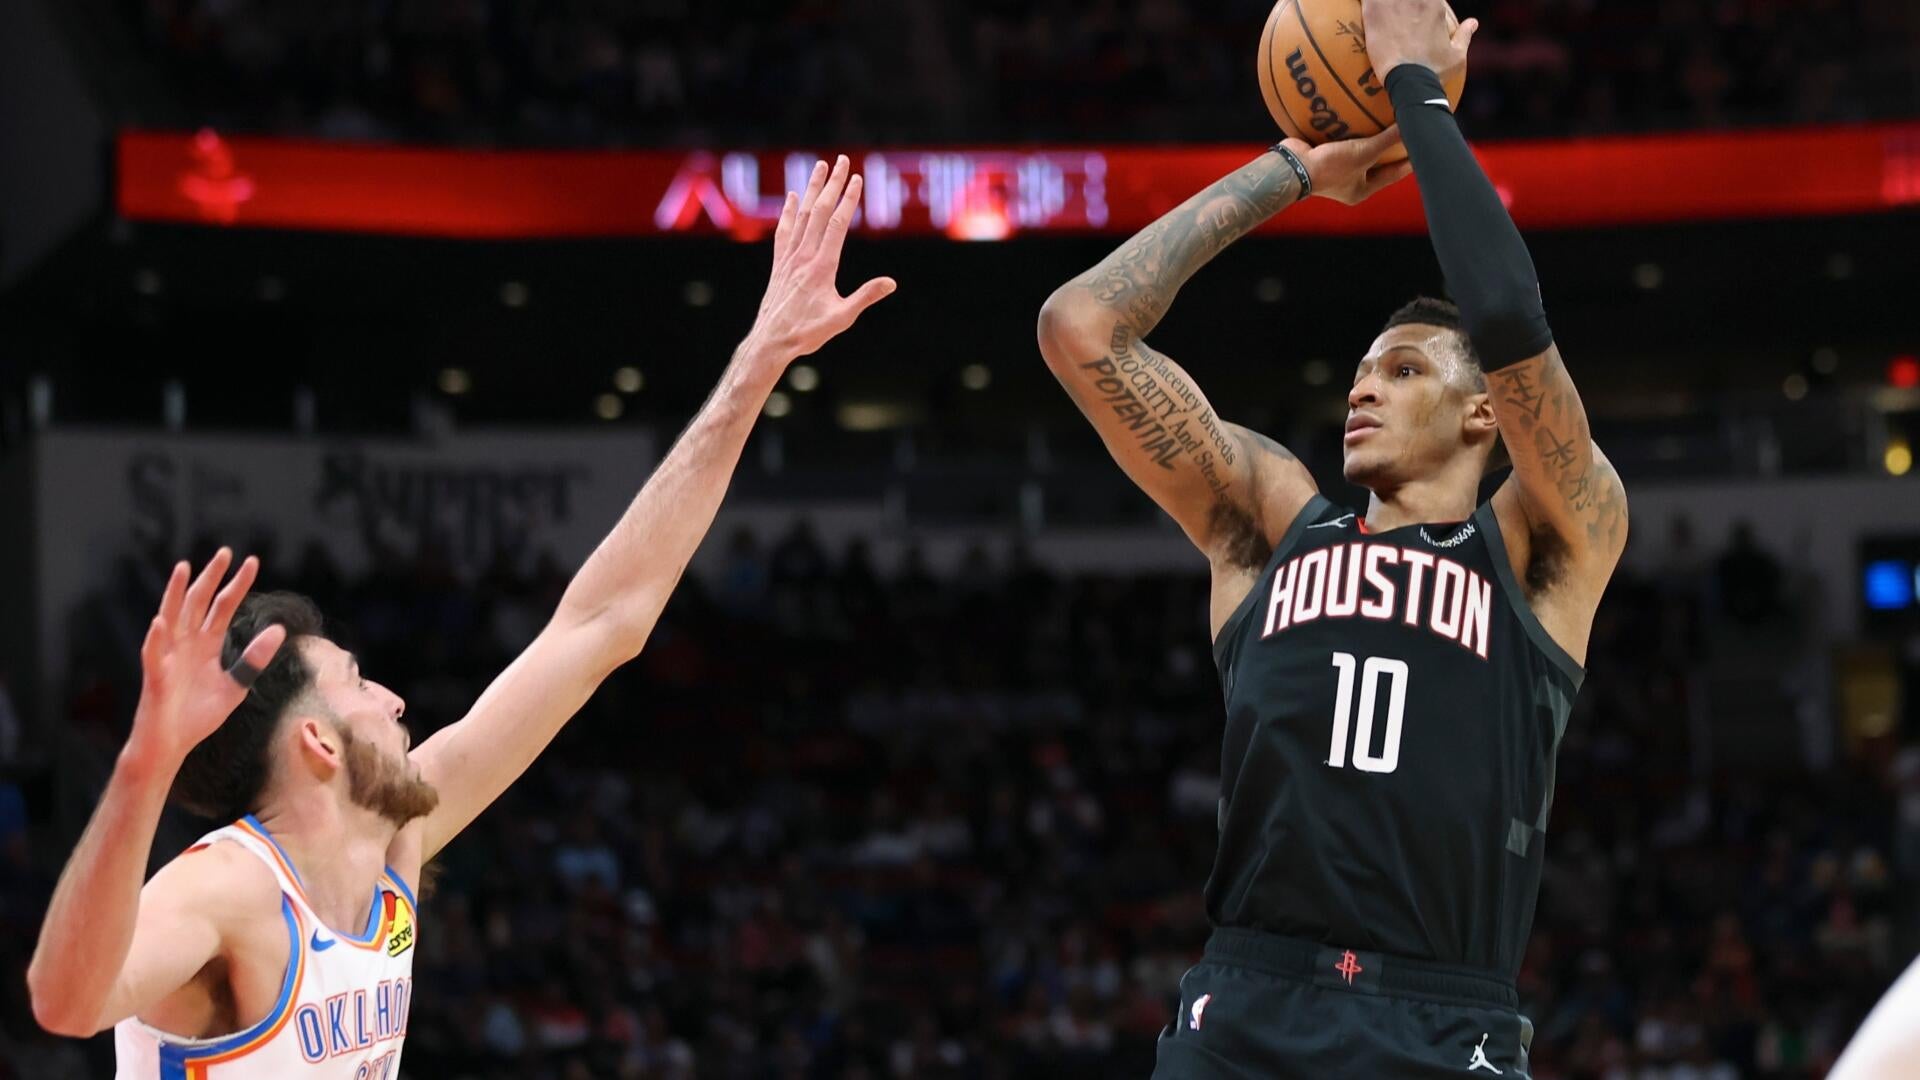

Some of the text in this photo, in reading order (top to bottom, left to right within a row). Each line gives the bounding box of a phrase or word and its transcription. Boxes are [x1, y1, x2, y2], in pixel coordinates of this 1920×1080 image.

[1080, 355, 1184, 471] POTENTIAL
[1168, 418, 1204, 454] And
[1198, 409, 1236, 466] Breeds
[1261, 543, 1492, 662] HOUSTON
[1327, 651, 1409, 774] 10
